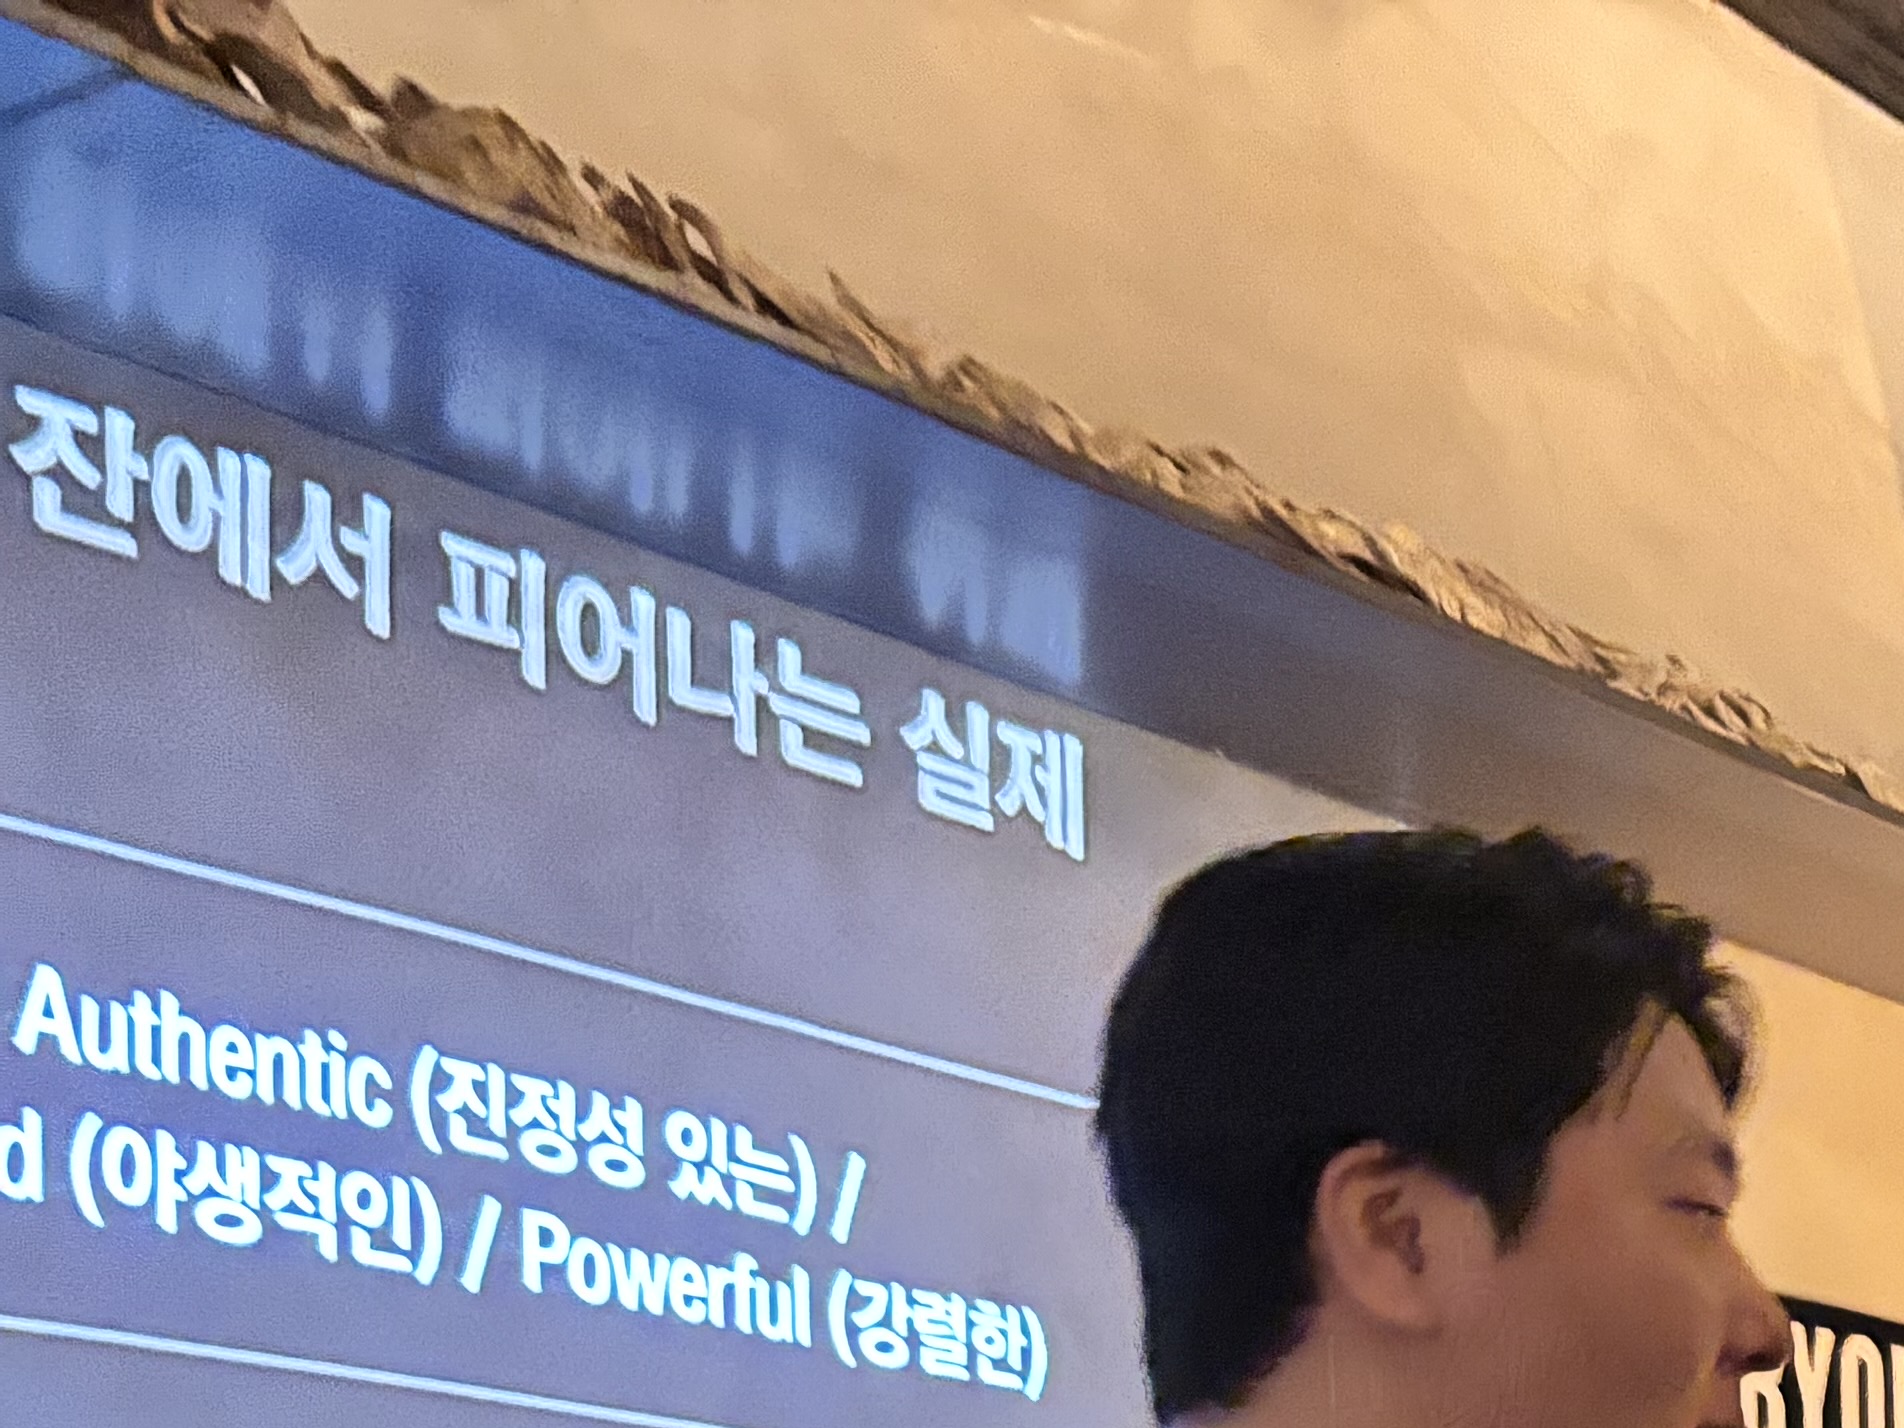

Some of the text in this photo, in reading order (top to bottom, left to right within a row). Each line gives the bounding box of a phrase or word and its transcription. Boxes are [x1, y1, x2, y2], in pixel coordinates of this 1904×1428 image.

[7, 384, 1087, 863] 잔에서 피어나는 실제
[11, 962, 867, 1245] Authentic (진정성 있는) /
[69, 1111, 443, 1287] (야생적인)
[460, 1194, 503, 1294] /
[519, 1207, 812, 1348] Powerful
[828, 1268, 1048, 1402] (강렬한)
